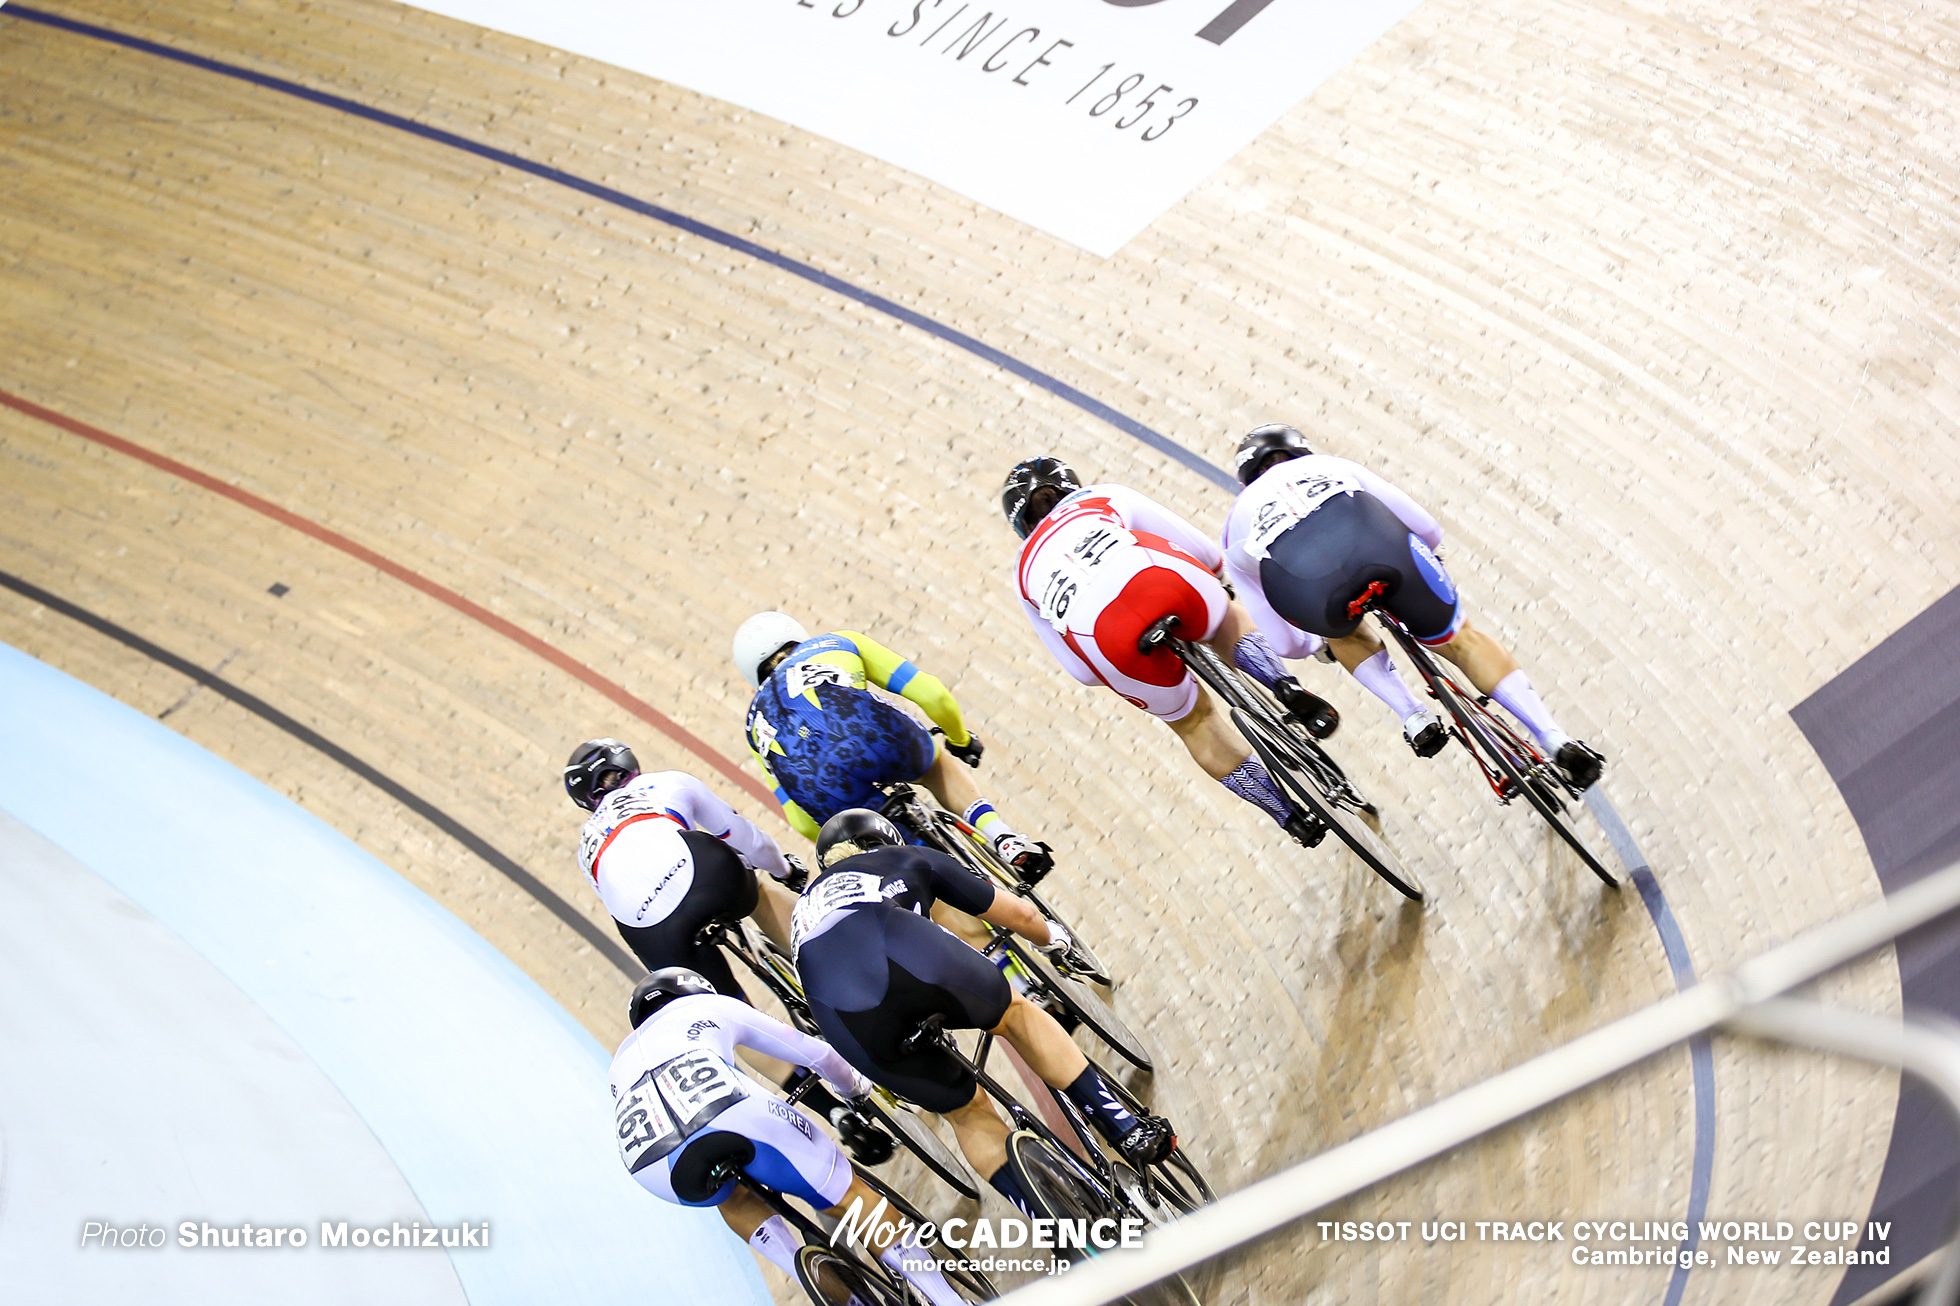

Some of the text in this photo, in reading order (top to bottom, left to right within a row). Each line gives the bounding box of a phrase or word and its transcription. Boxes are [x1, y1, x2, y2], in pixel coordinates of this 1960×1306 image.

[887, 0, 1074, 86] SINCE
[1065, 62, 1199, 142] 1853
[1042, 569, 1078, 619] 116
[636, 858, 687, 921] COLNAGO
[687, 1020, 720, 1042] KOREA
[668, 1057, 727, 1104] 167
[616, 1095, 657, 1153] 167
[767, 1100, 812, 1141] KOREA
